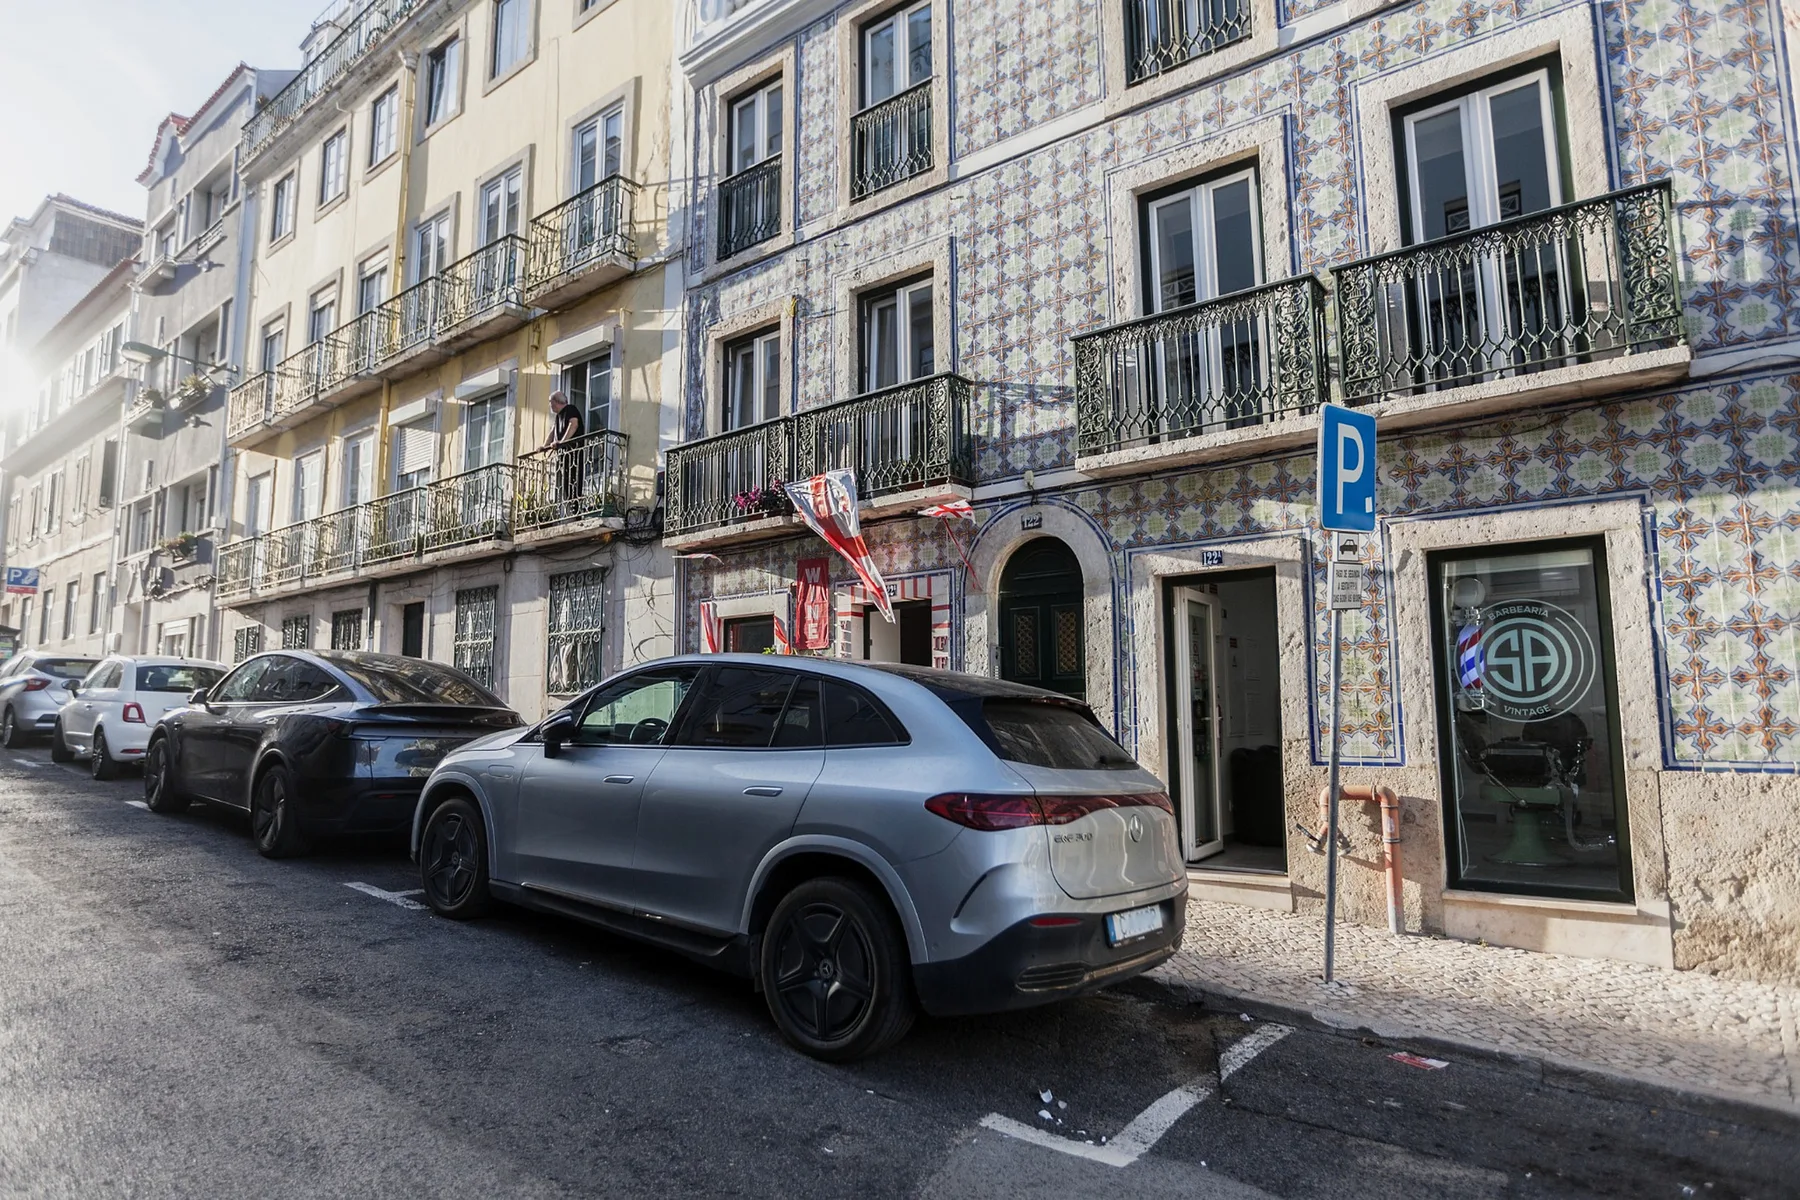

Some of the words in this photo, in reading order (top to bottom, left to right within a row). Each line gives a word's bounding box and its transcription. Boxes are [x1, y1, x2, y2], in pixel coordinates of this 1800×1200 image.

[1336, 422, 1365, 515] P
[1022, 514, 1040, 528] 122
[10, 569, 23, 582] P
[804, 566, 821, 640] WINE
[1488, 605, 1549, 621] BARBEARIA
[1487, 629, 1559, 692] SA
[1503, 704, 1551, 716] VINTAGE
